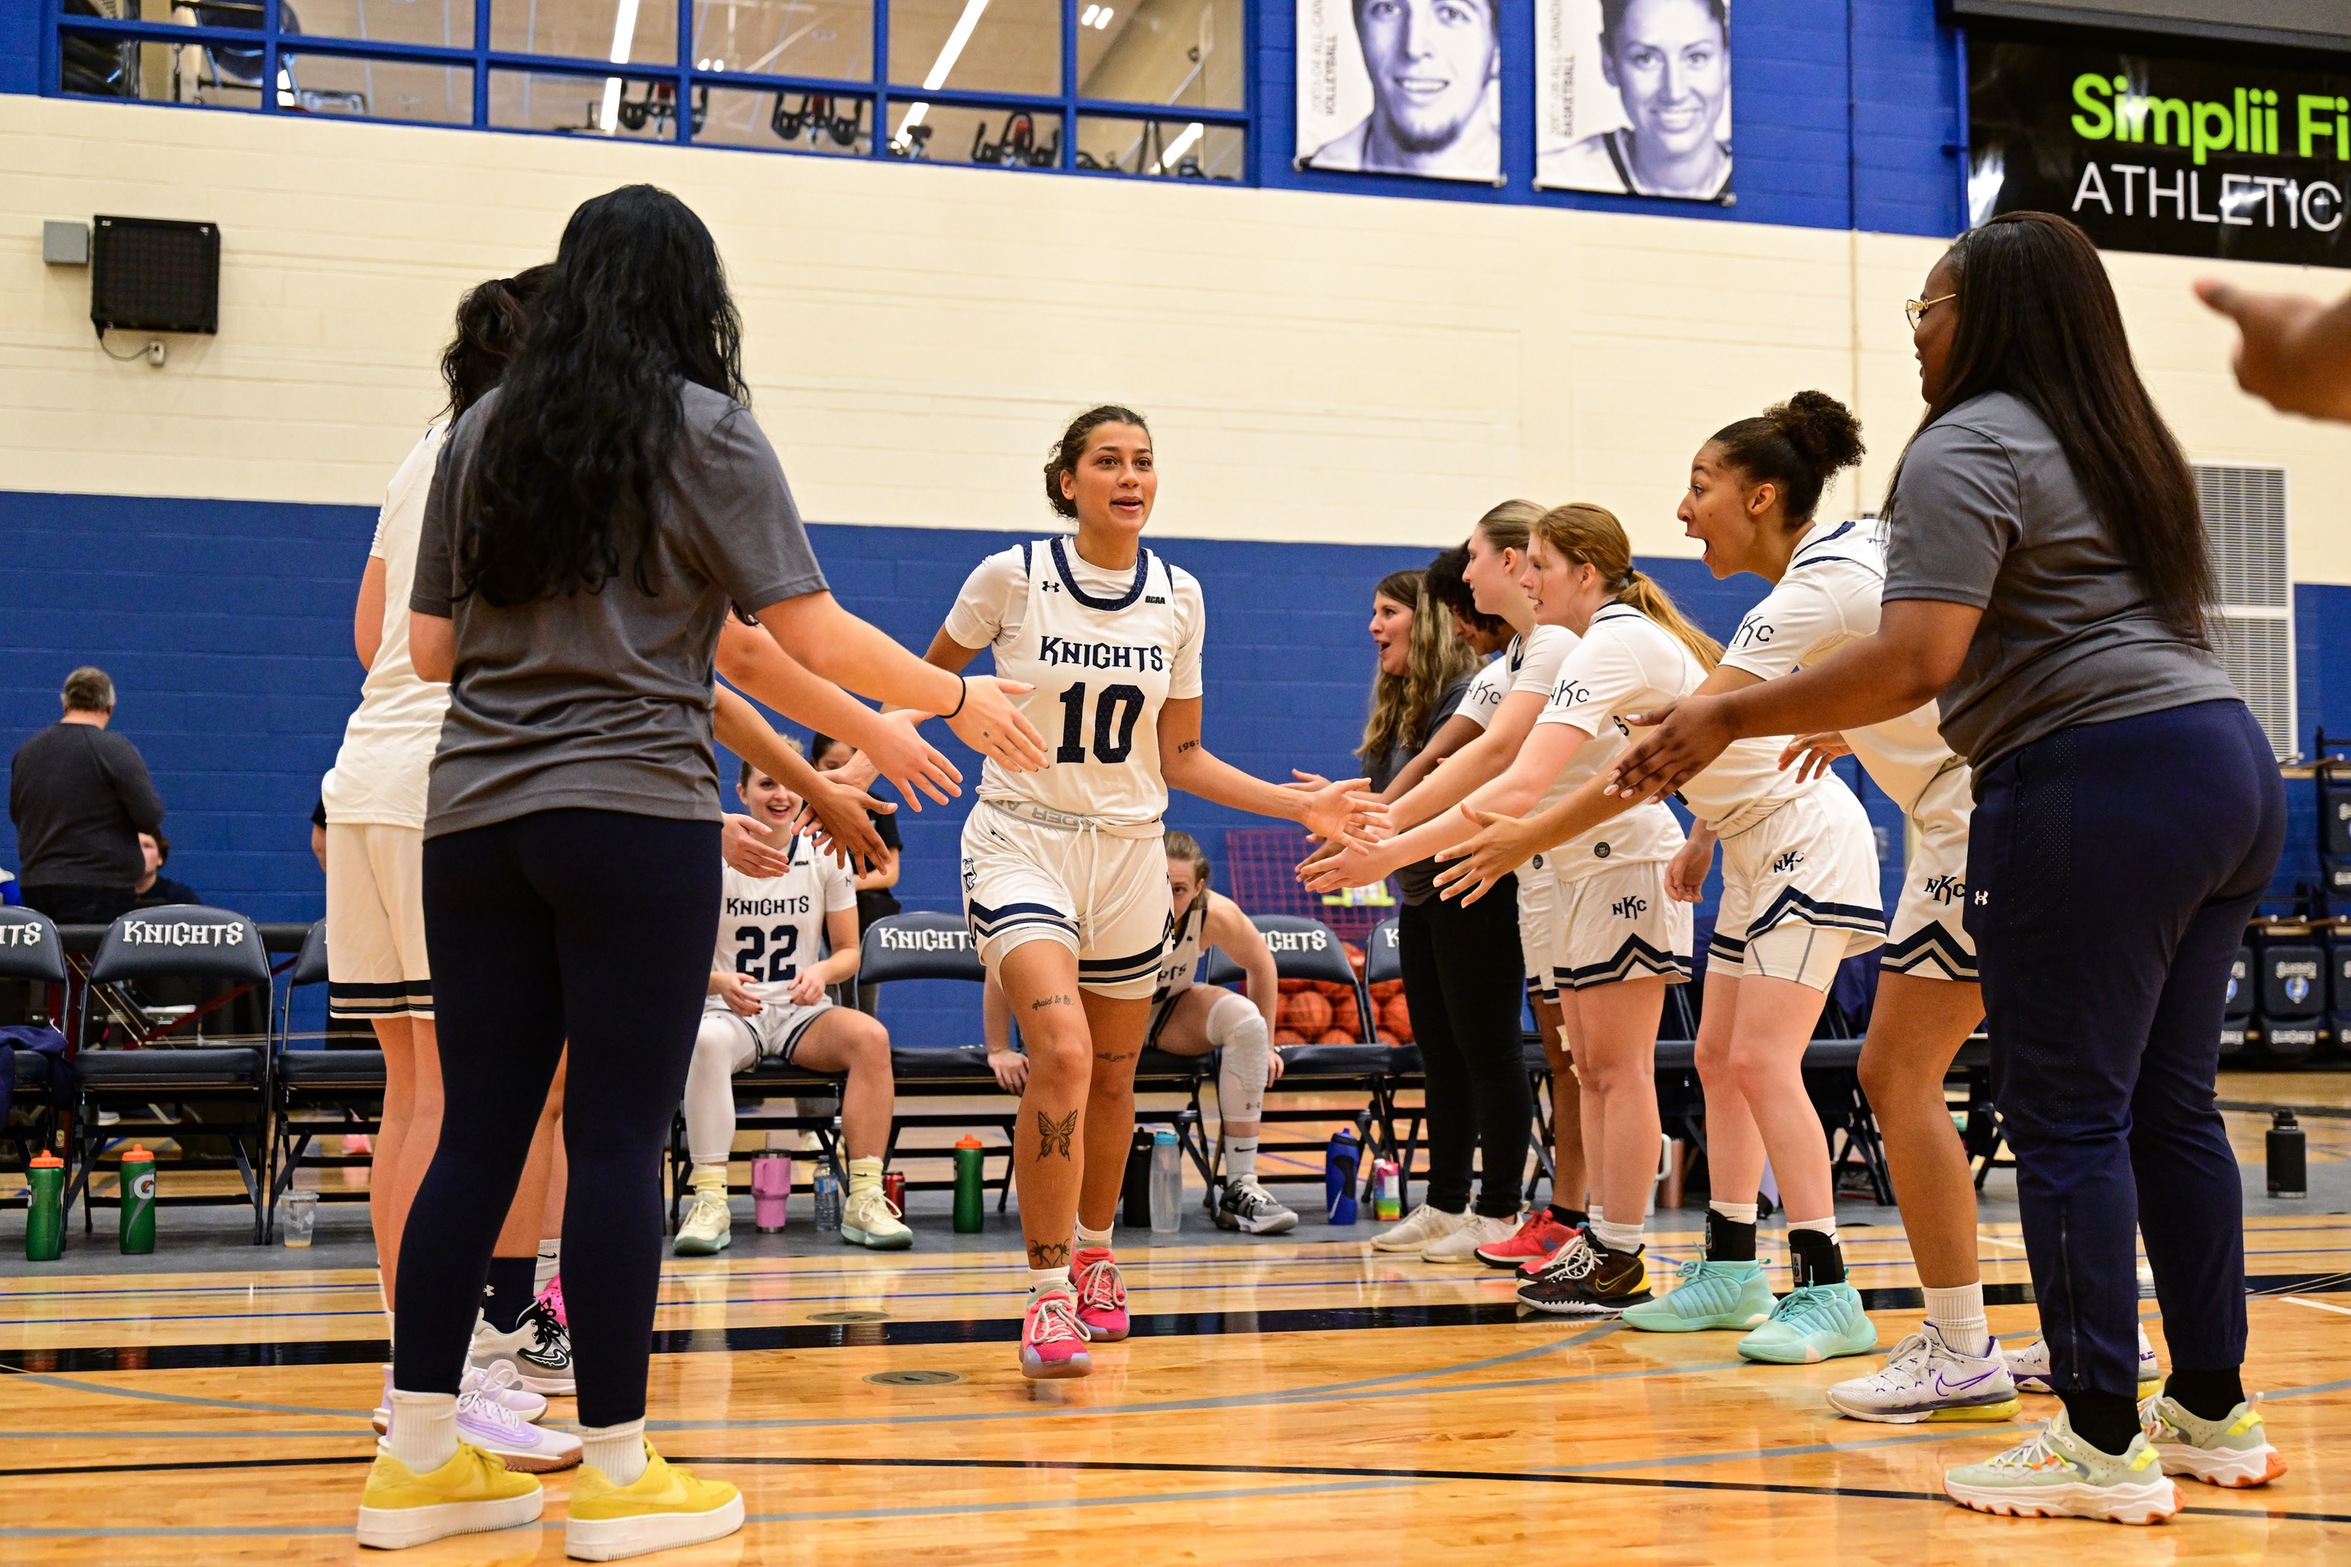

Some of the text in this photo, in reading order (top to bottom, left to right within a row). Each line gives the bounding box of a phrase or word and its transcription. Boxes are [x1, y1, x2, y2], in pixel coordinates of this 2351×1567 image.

[1325, 34, 1337, 115] VOLLEYBALL
[1562, 54, 1575, 137] BASKETBALL
[2071, 73, 2279, 165] Simplii
[2071, 161, 2343, 232] ATHLETIC
[1038, 635, 1163, 673] KNIGHTS
[1056, 681, 1146, 764] 10
[122, 920, 244, 948] KNIGHTS
[726, 895, 809, 917] KNIGHTS
[1611, 895, 1648, 920] NKC
[735, 924, 799, 983] 22
[879, 927, 974, 952] KNIGHT
